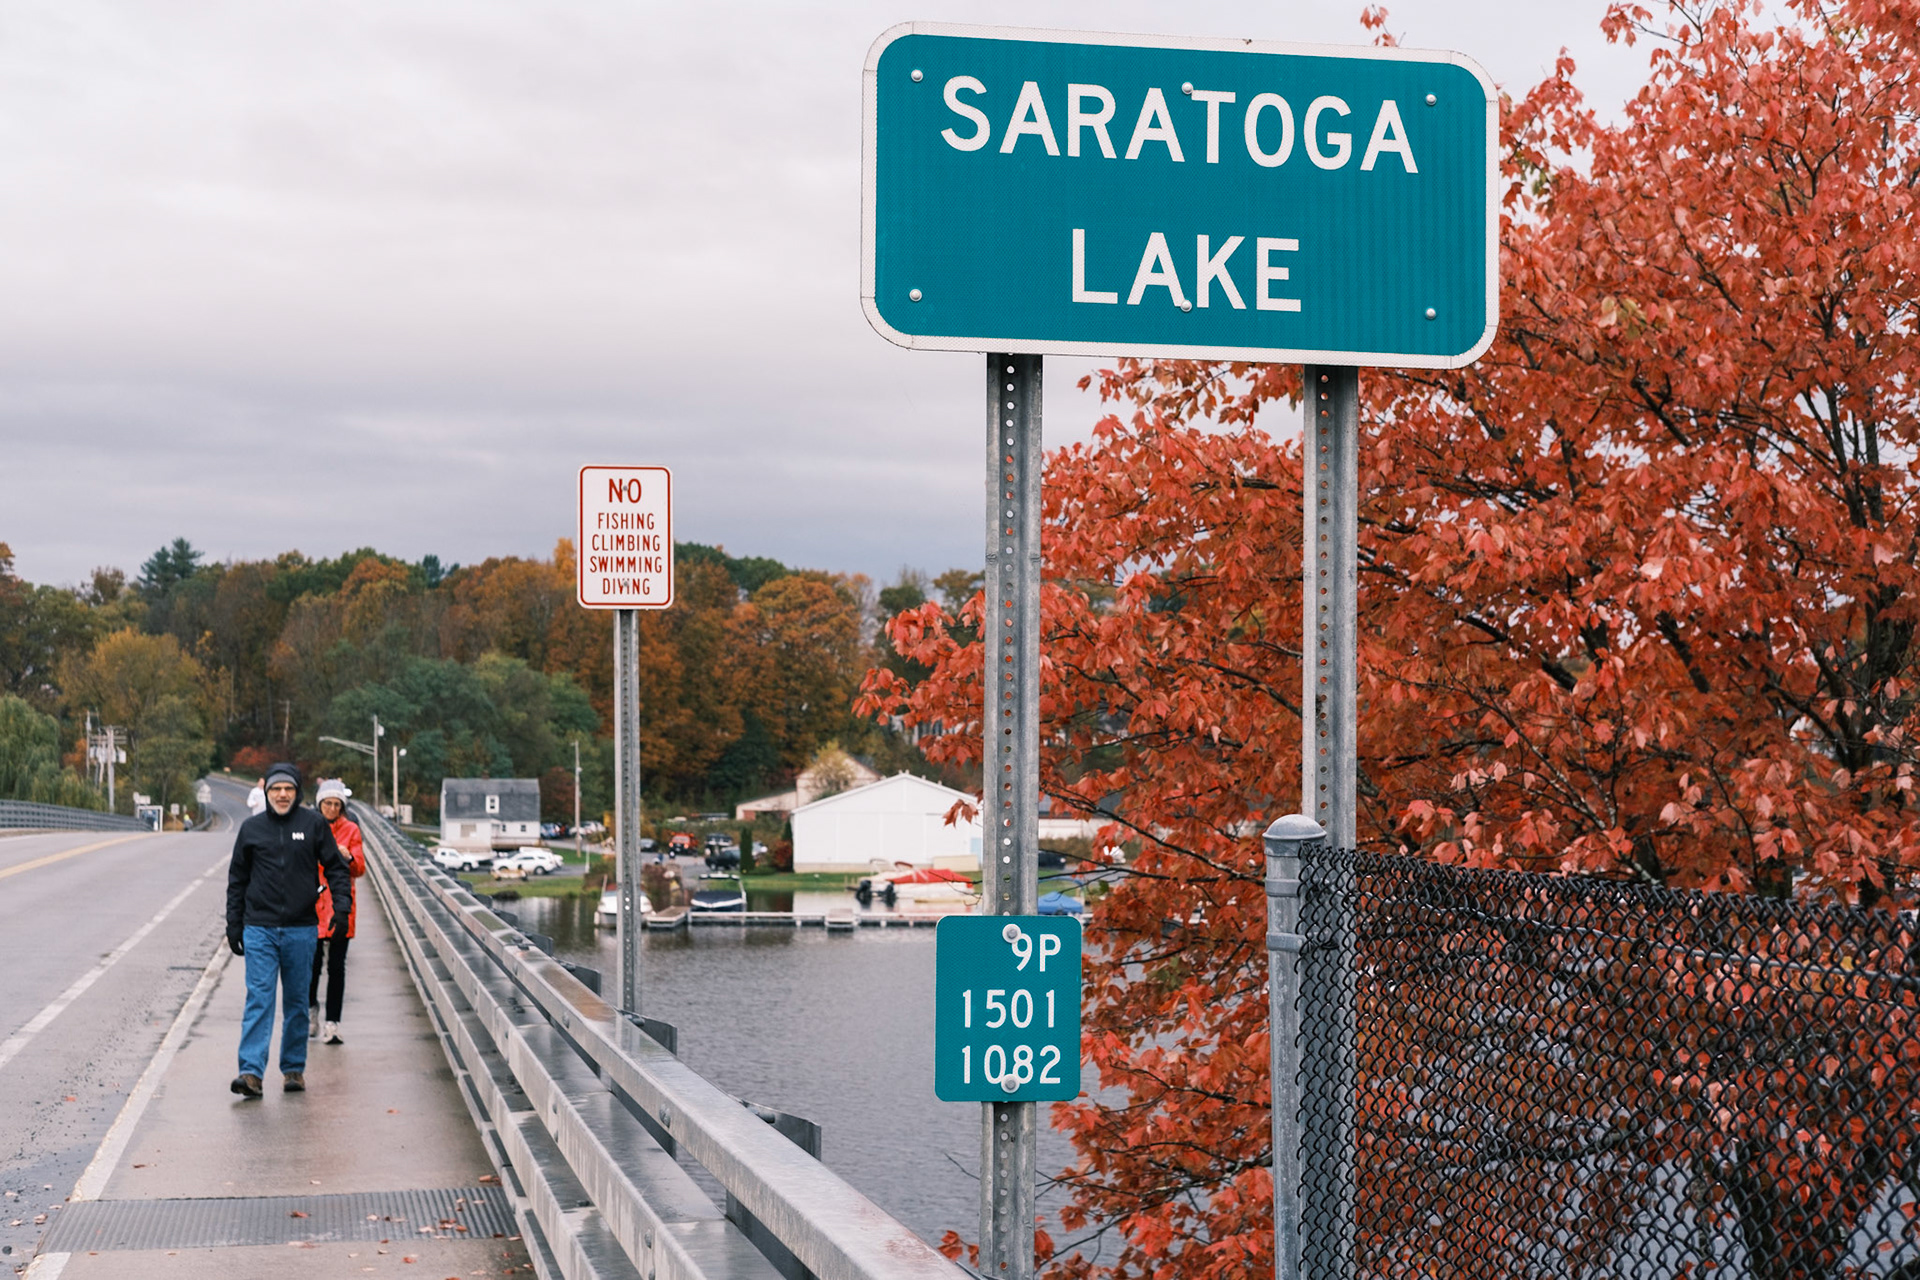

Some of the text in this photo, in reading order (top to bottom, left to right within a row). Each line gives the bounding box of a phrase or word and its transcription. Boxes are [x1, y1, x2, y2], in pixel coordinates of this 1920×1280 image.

[940, 74, 1419, 174] SARATOGA
[1072, 228, 1302, 313] LAKE
[609, 478, 642, 504] NO
[598, 512, 655, 530] FISHING
[592, 534, 660, 552] CLIMBING
[590, 555, 662, 574] SWIMMING
[602, 578, 650, 595] DIVING
[1011, 933, 1062, 972] 9P
[962, 989, 1055, 1028] 1501
[961, 1044, 1061, 1084] 1082
